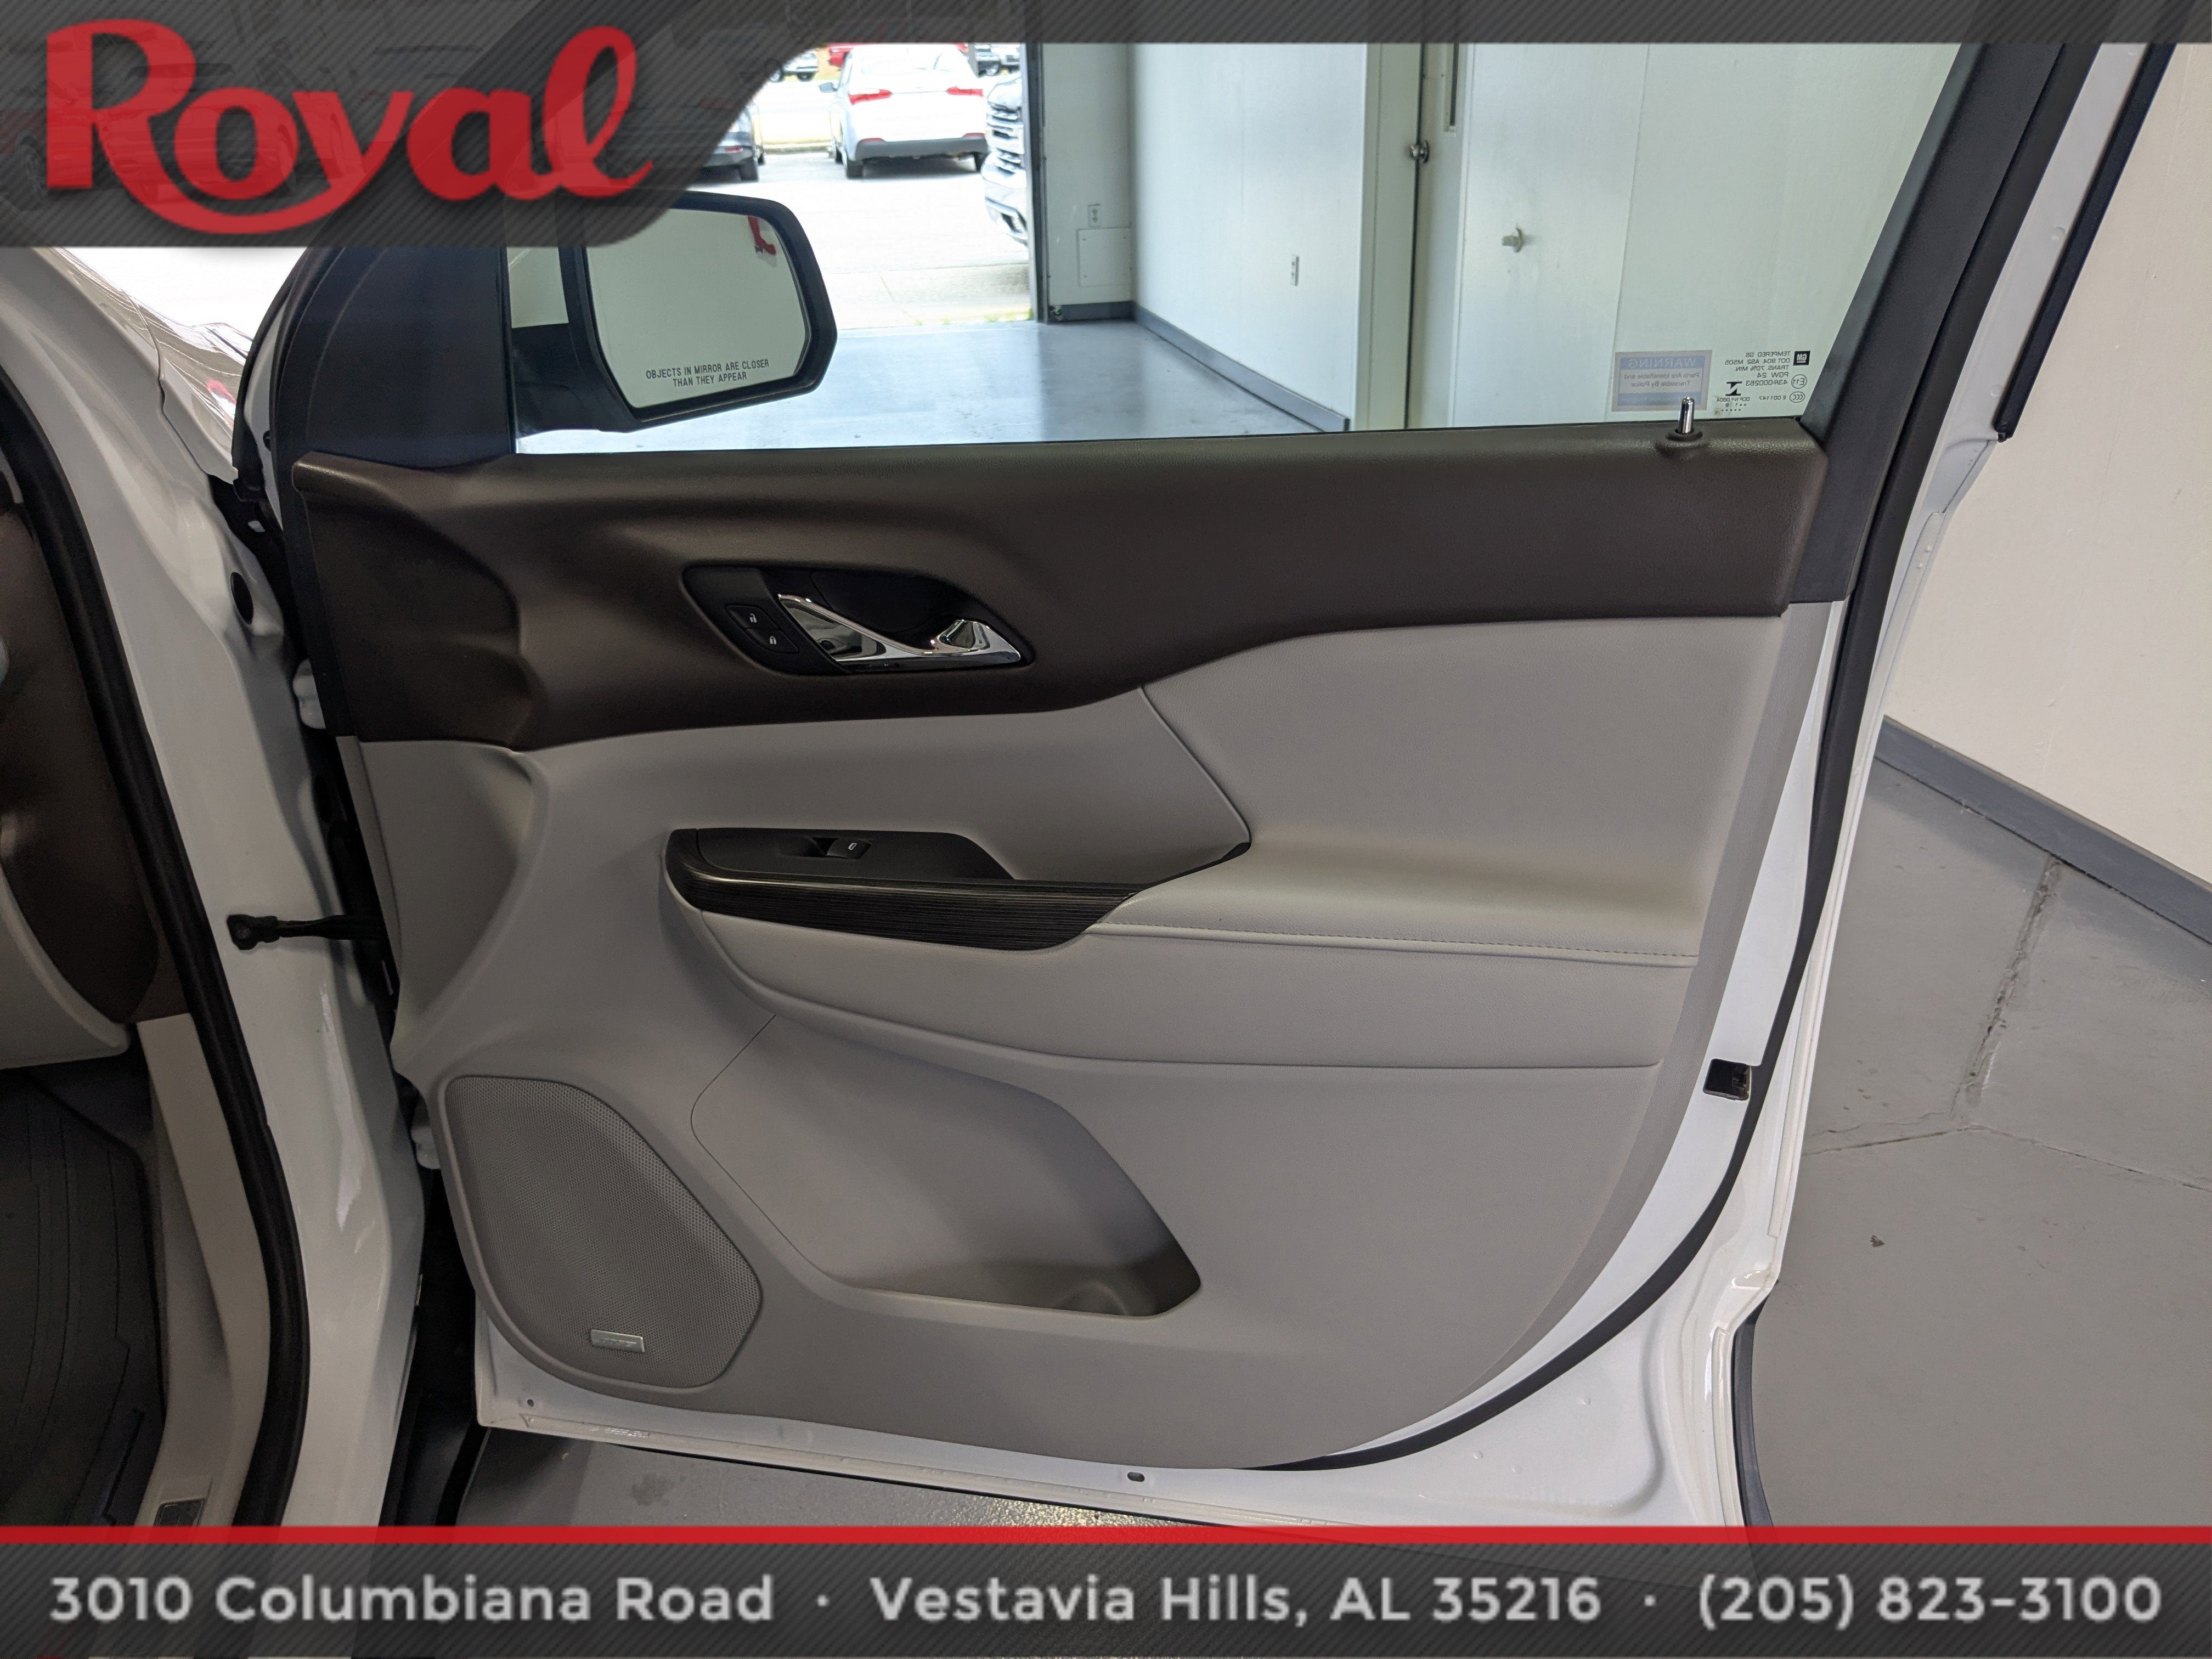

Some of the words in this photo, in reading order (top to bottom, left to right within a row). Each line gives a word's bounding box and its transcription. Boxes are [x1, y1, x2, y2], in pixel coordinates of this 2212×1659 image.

[646, 368, 681, 379] OBJECTS
[684, 366, 691, 375] IN
[694, 363, 723, 374] MIRROR
[725, 361, 739, 371] ARE
[742, 359, 769, 369] CLOSER
[673, 378, 693, 387] THAN
[696, 375, 716, 385] THEY
[719, 372, 747, 382] APPEAR
